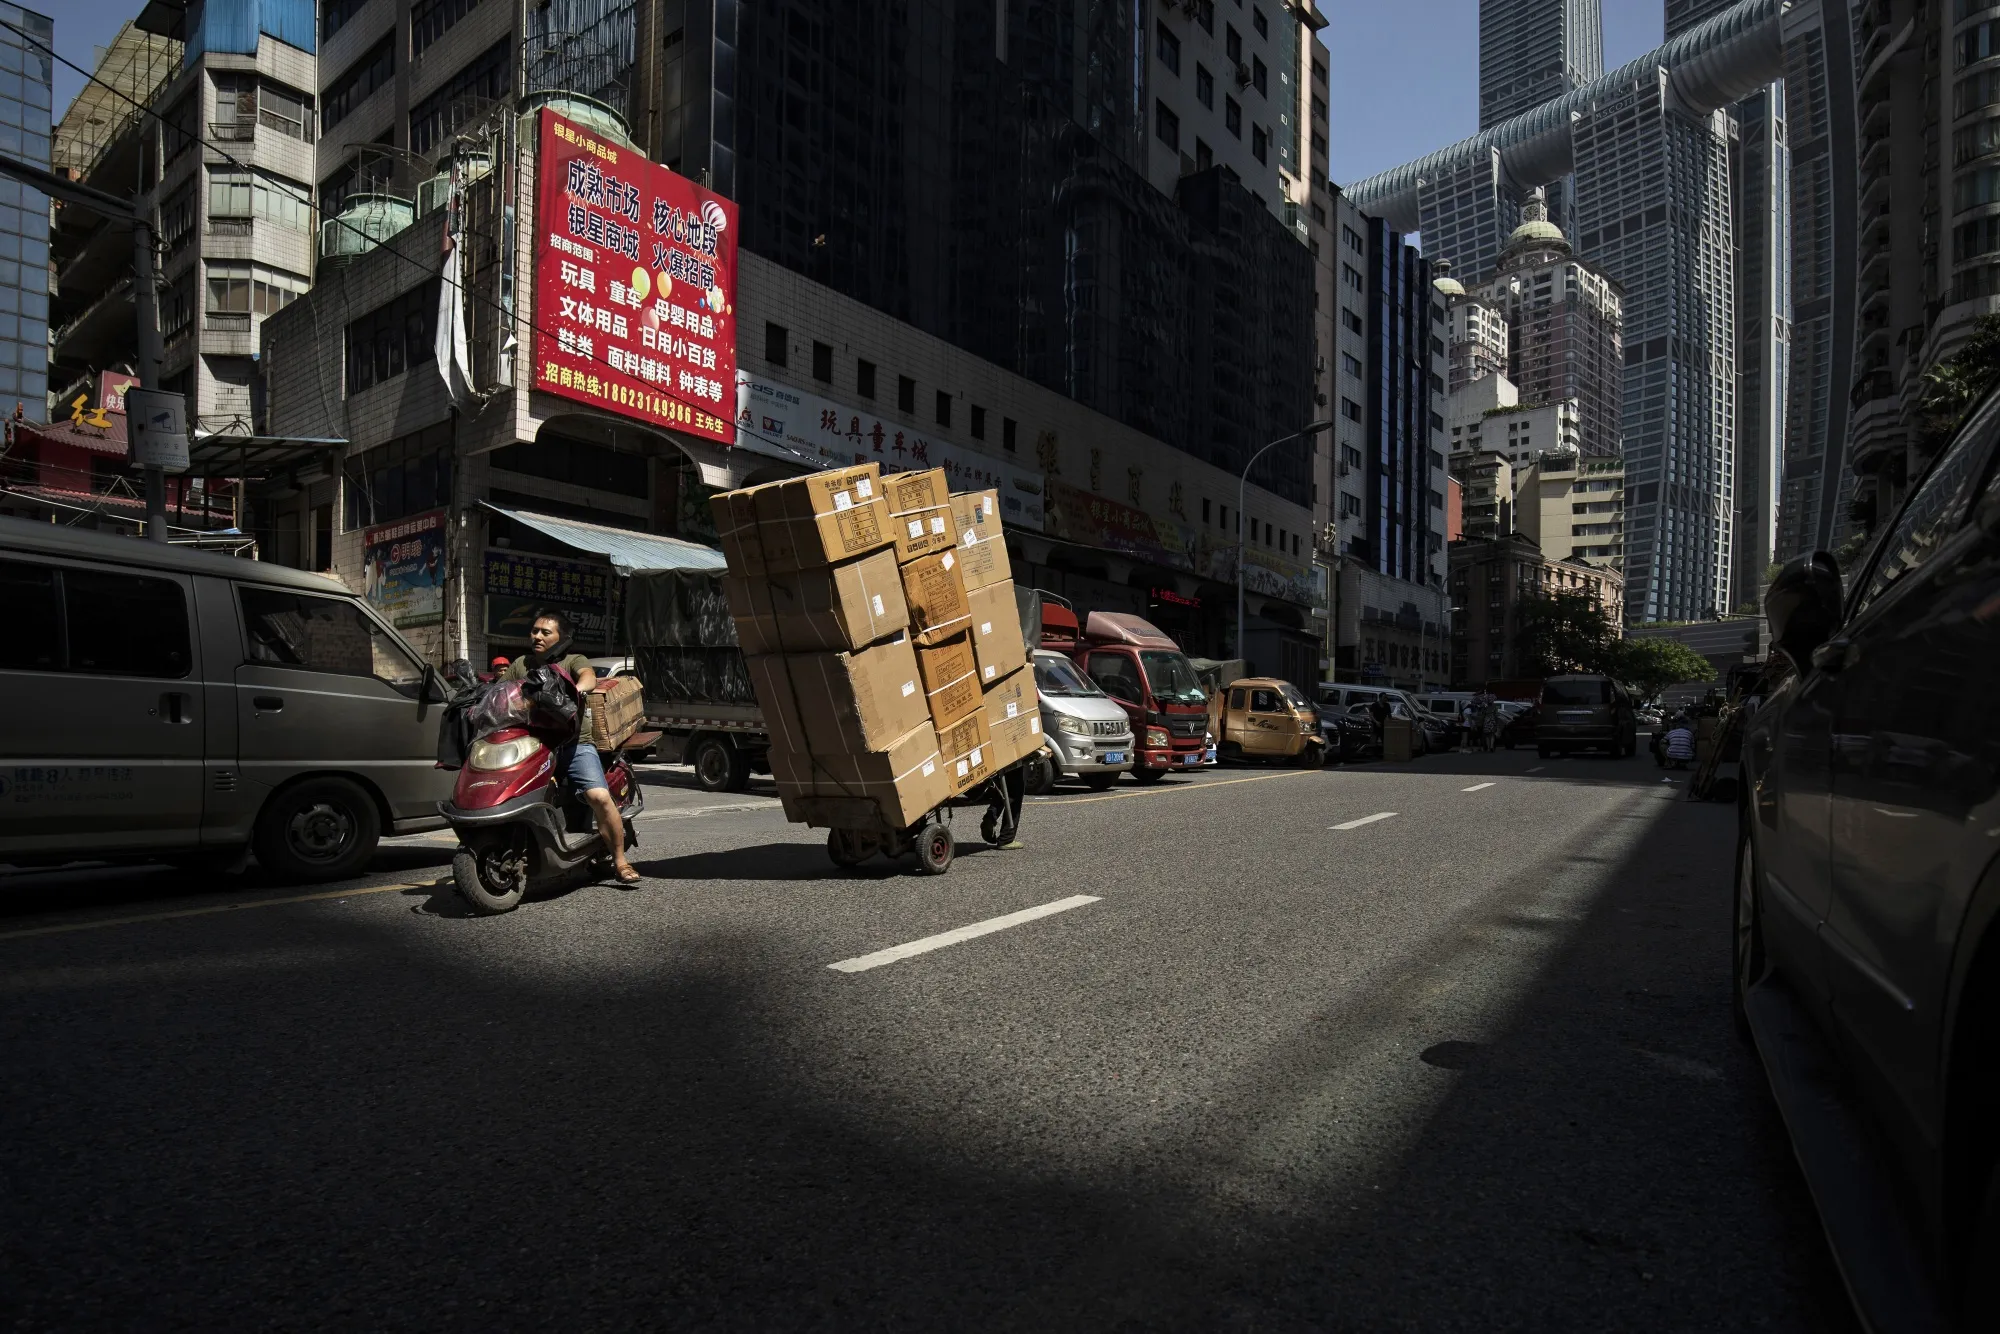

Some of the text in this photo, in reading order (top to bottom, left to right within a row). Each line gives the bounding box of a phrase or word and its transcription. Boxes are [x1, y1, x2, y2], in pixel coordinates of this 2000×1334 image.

[553, 122, 618, 165] 银星小商品城
[567, 158, 717, 259] 成熟市场 核心地段
[568, 203, 715, 292] 银星商城 火爆招商
[559, 296, 716, 371] 文体用品 日用小百货
[560, 260, 714, 340] 玩具 童车 母婴用品
[558, 328, 723, 402] 鞋类 面料辅料 钟表等
[71, 392, 112, 429] 红
[695, 411, 724, 435] 王先生
[820, 408, 931, 468] 玩具童车城
